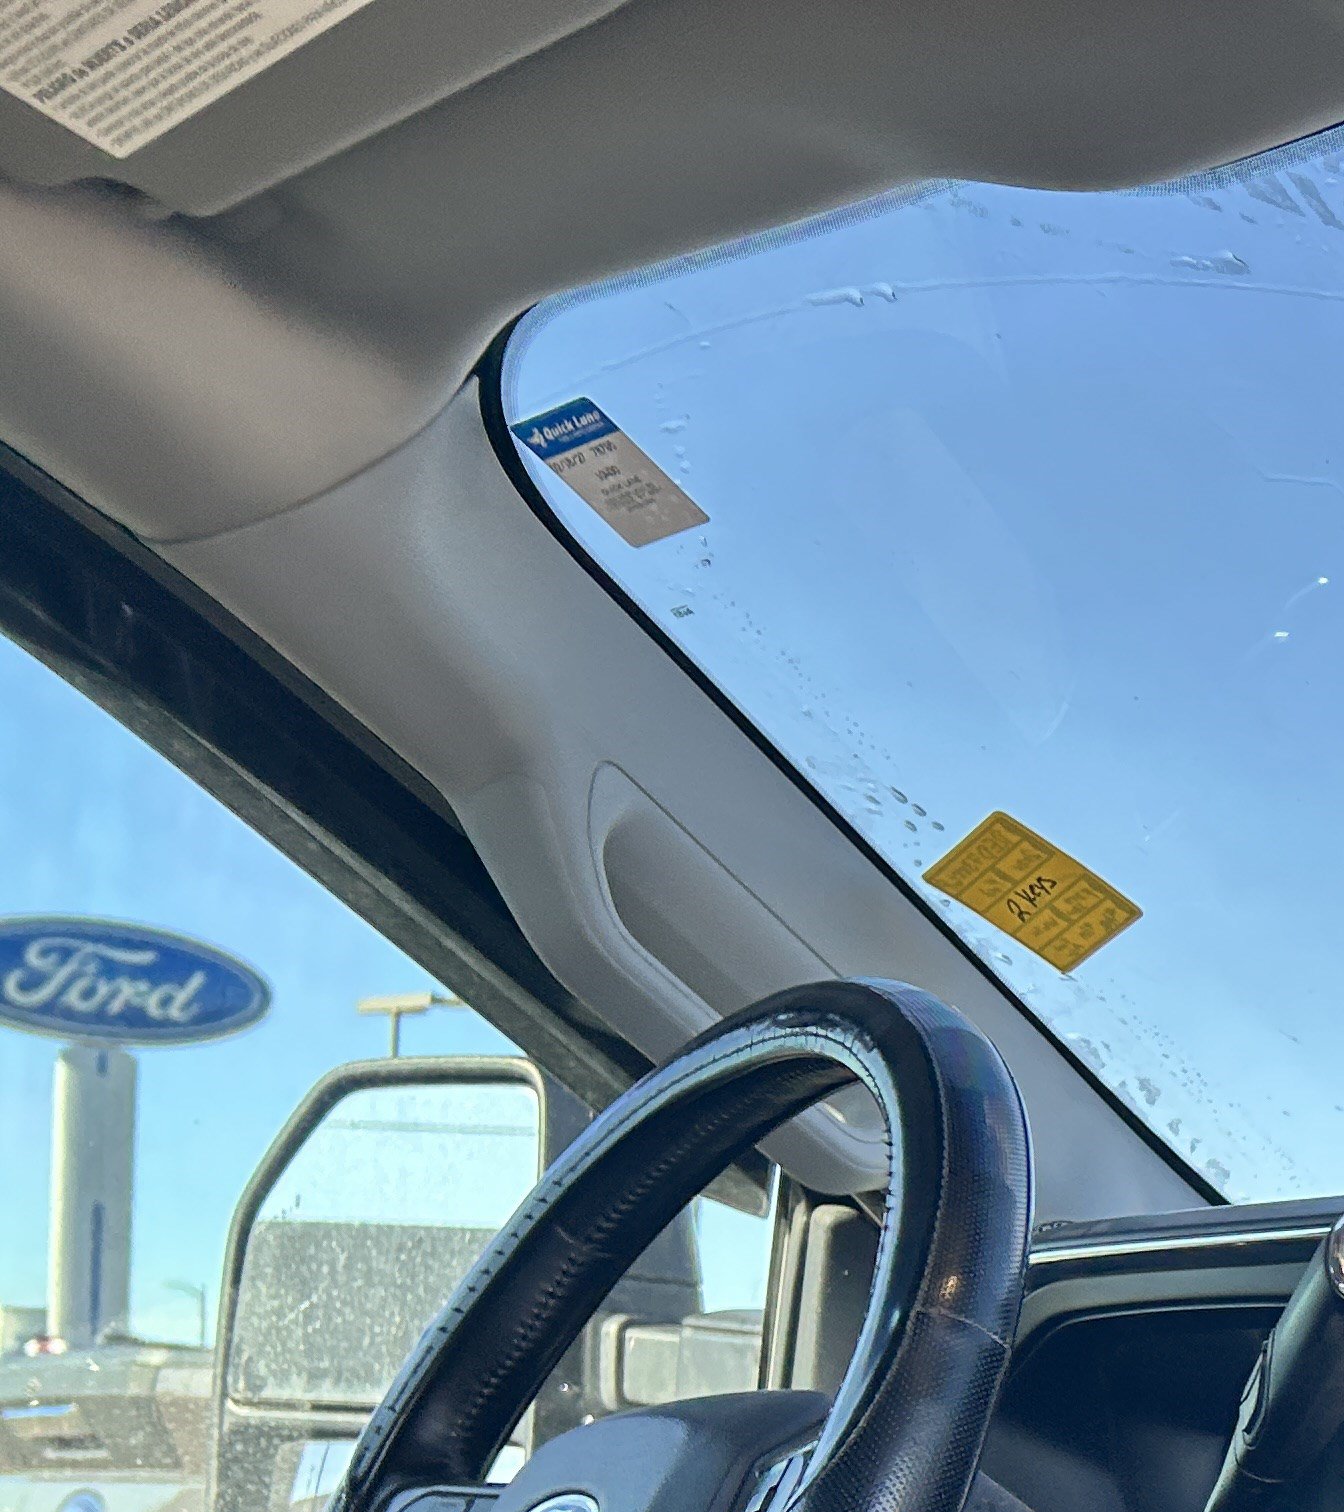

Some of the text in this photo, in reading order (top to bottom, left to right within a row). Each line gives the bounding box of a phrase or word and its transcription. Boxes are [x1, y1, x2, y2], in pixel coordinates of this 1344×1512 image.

[543, 414, 574, 441] Quick
[1007, 899, 1032, 923] 2
[3, 936, 207, 1023] Ford
